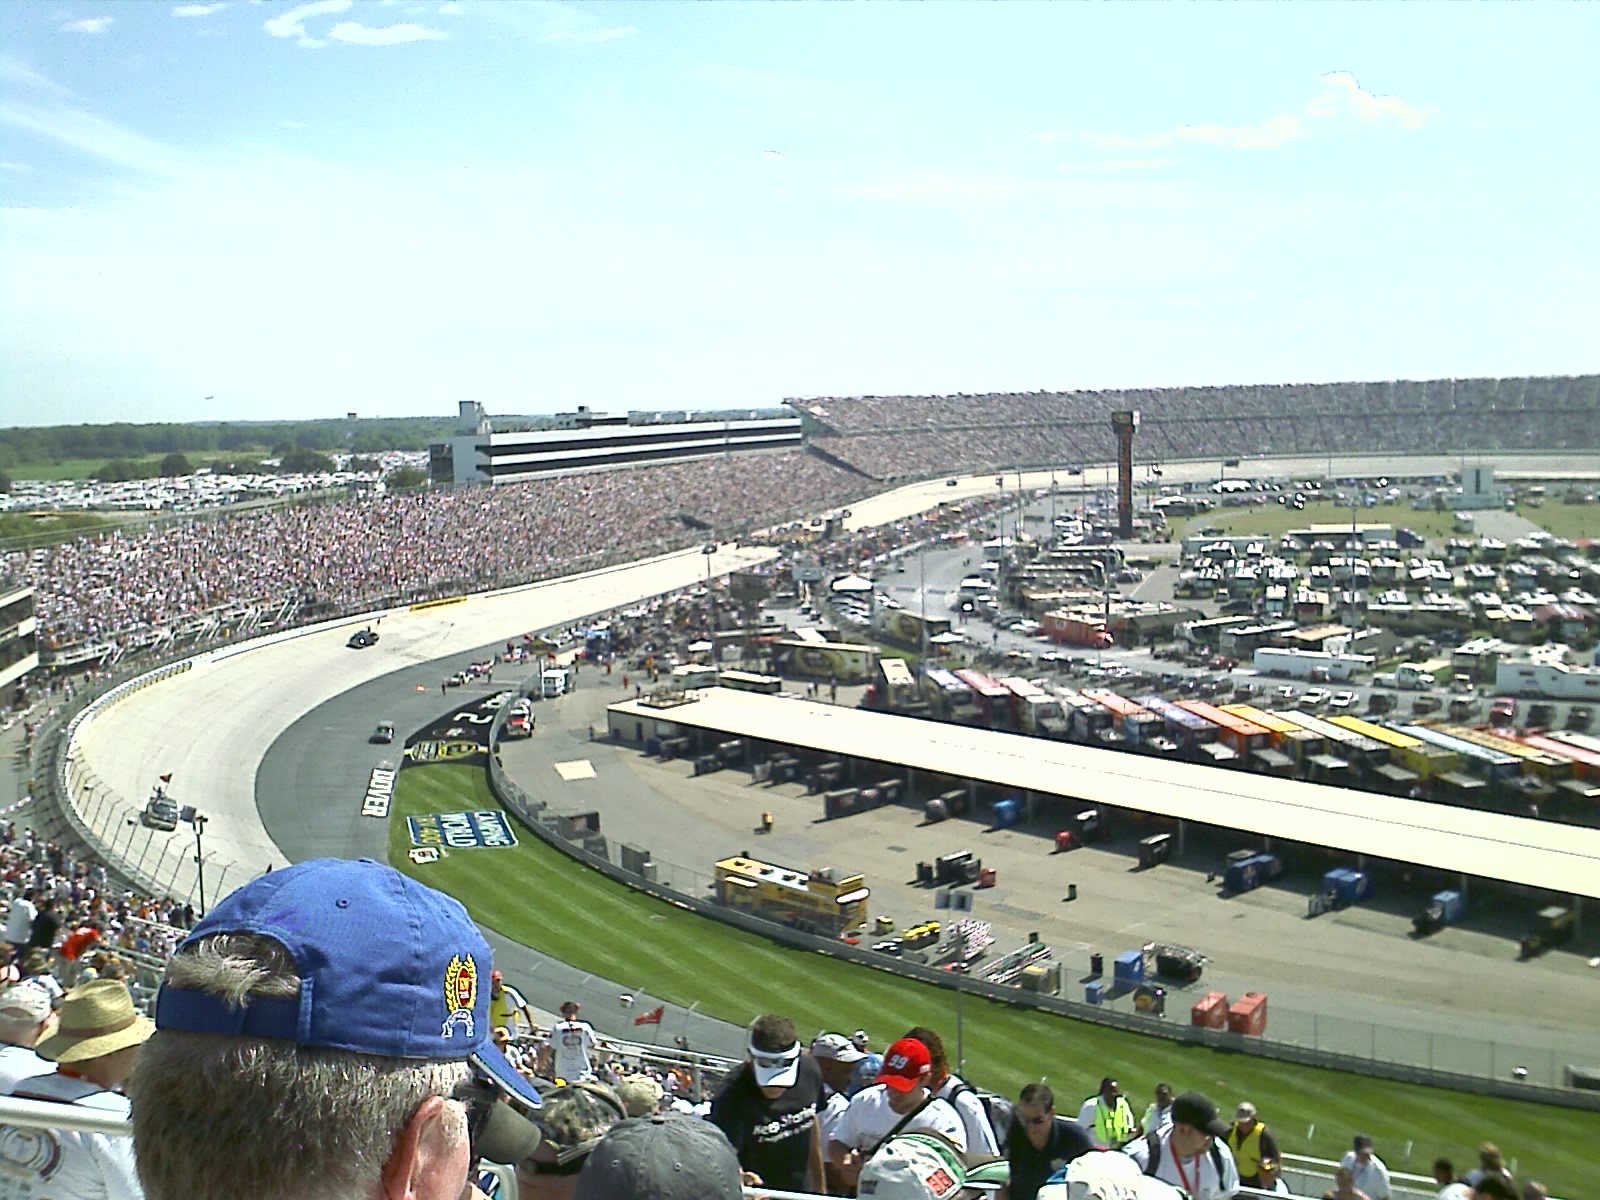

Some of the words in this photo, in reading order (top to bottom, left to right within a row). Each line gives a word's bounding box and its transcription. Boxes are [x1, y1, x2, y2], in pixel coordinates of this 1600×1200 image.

[361, 768, 397, 818] DOVER
[440, 813, 478, 847] WORLD
[474, 811, 511, 847] CAMPING
[888, 1054, 910, 1070] 99
